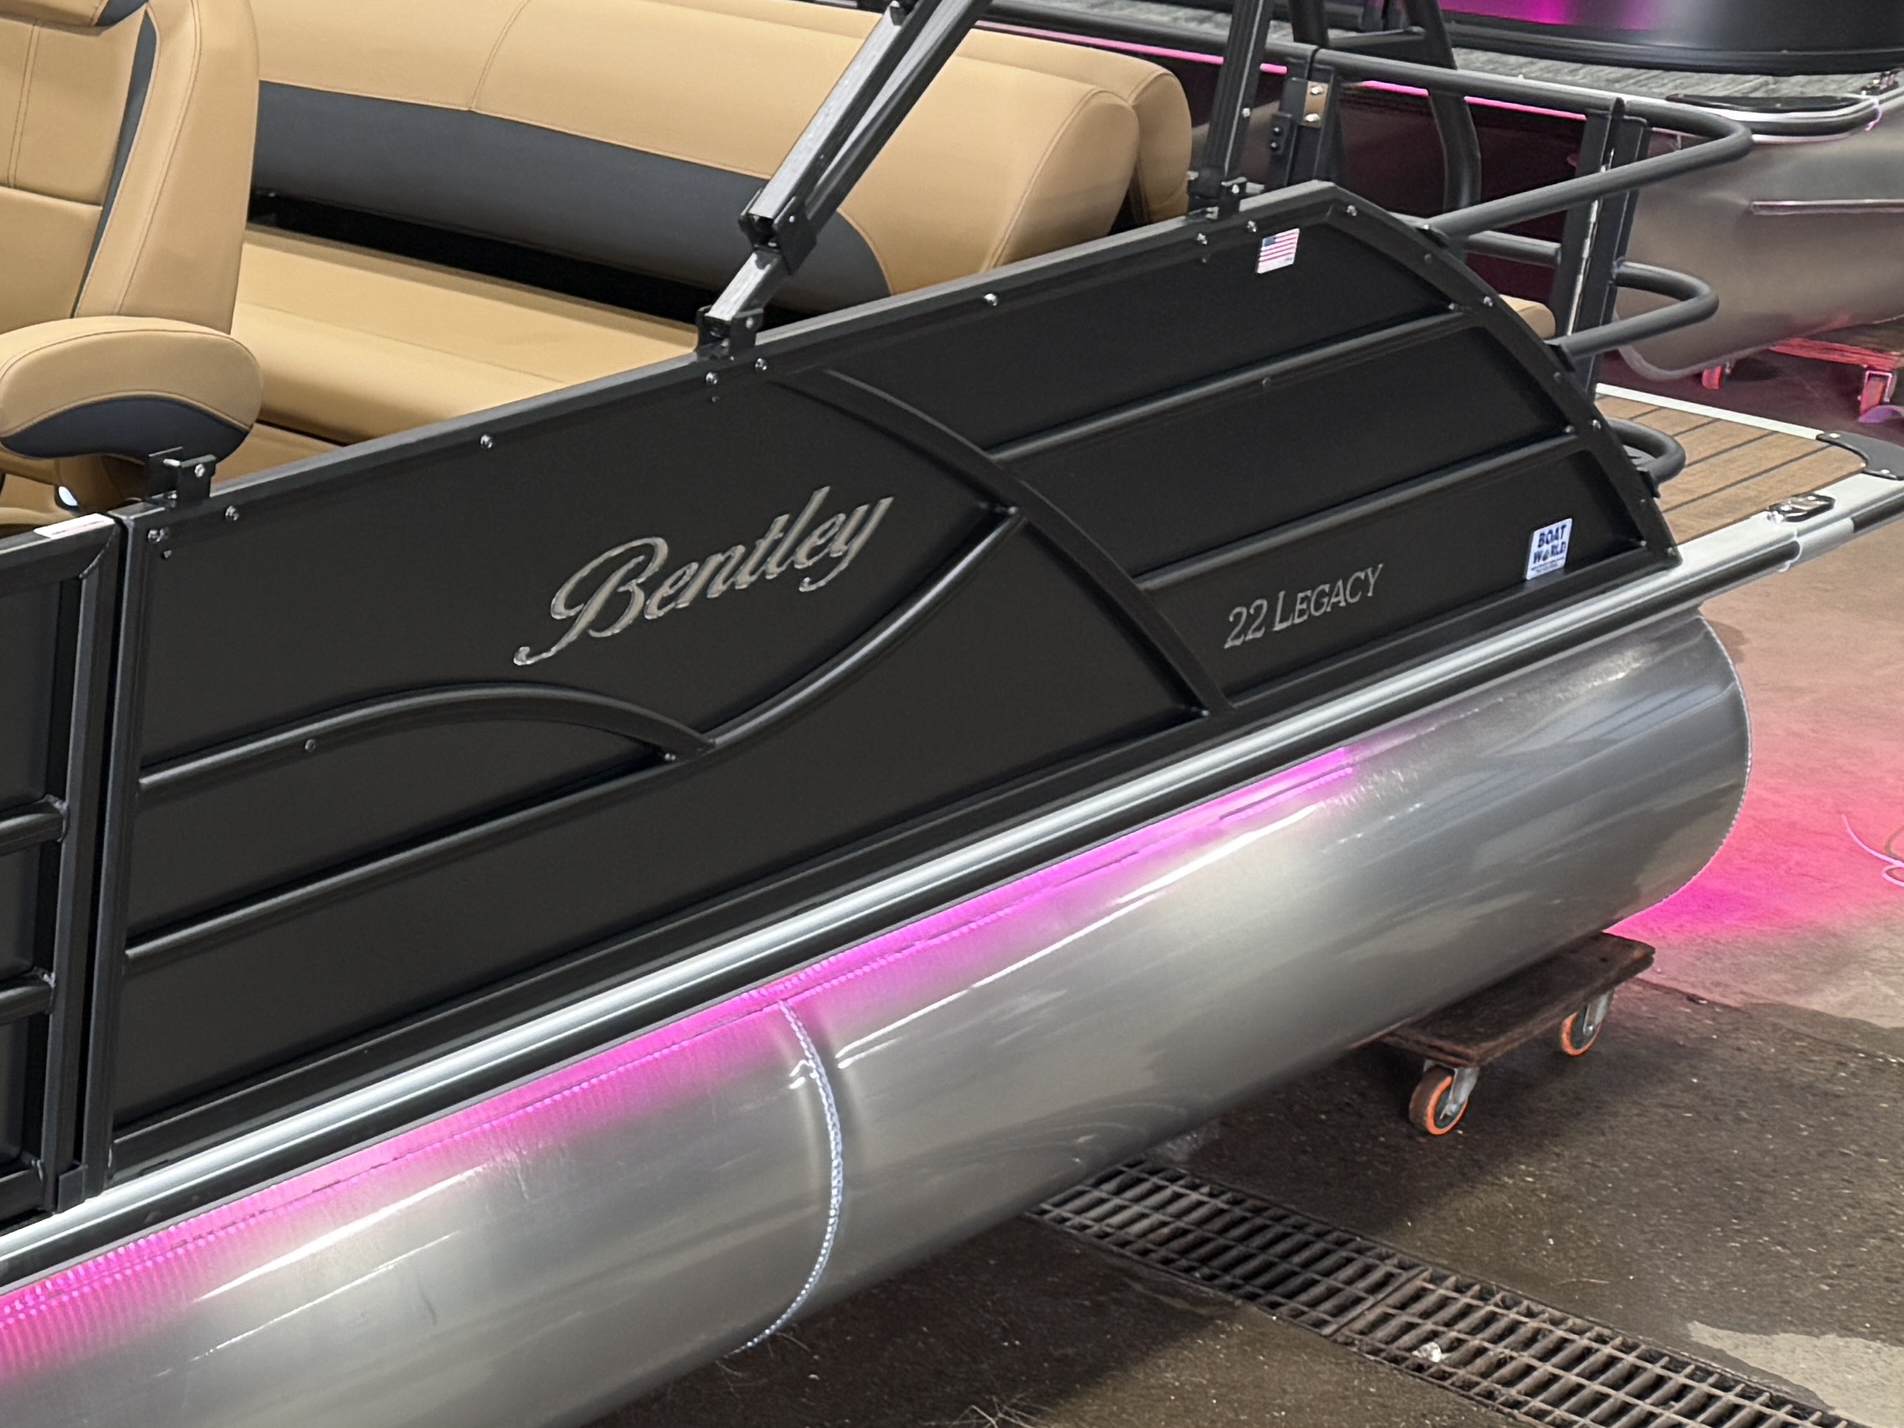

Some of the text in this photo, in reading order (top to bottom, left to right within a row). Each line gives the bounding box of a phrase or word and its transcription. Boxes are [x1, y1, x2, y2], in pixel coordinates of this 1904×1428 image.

[512, 485, 894, 667] Bentley
[1537, 524, 1567, 549] BOAT
[1223, 563, 1385, 650] 22 LEGACY
